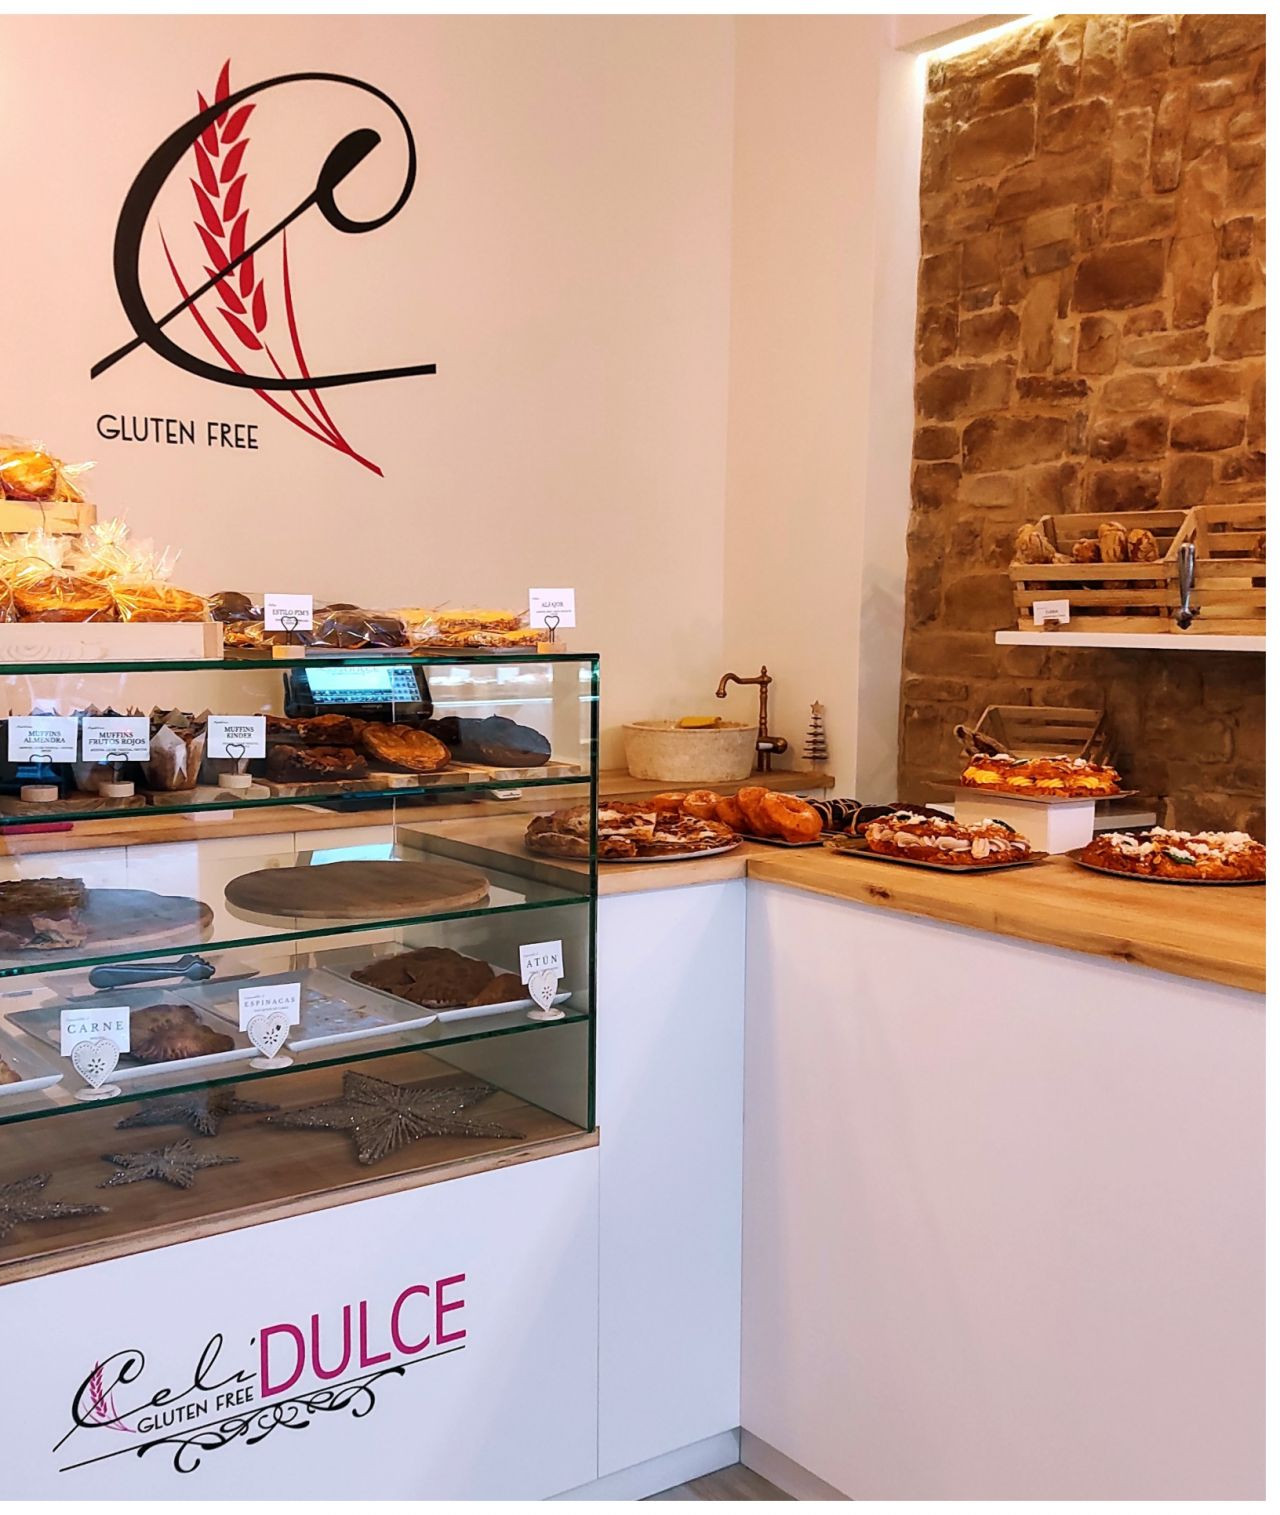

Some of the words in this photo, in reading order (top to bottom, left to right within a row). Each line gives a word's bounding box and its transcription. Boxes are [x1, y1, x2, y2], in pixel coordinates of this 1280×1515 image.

[96, 414, 195, 445] GLUTEN
[207, 421, 259, 450] FREE
[99, 731, 134, 739] MUFFINS
[121, 738, 146, 746] ROJOS
[243, 996, 296, 1008] ESPINACAS
[66, 1020, 125, 1034] CARNE
[136, 1400, 209, 1435] GLUTEN
[215, 1385, 255, 1412] FREE
